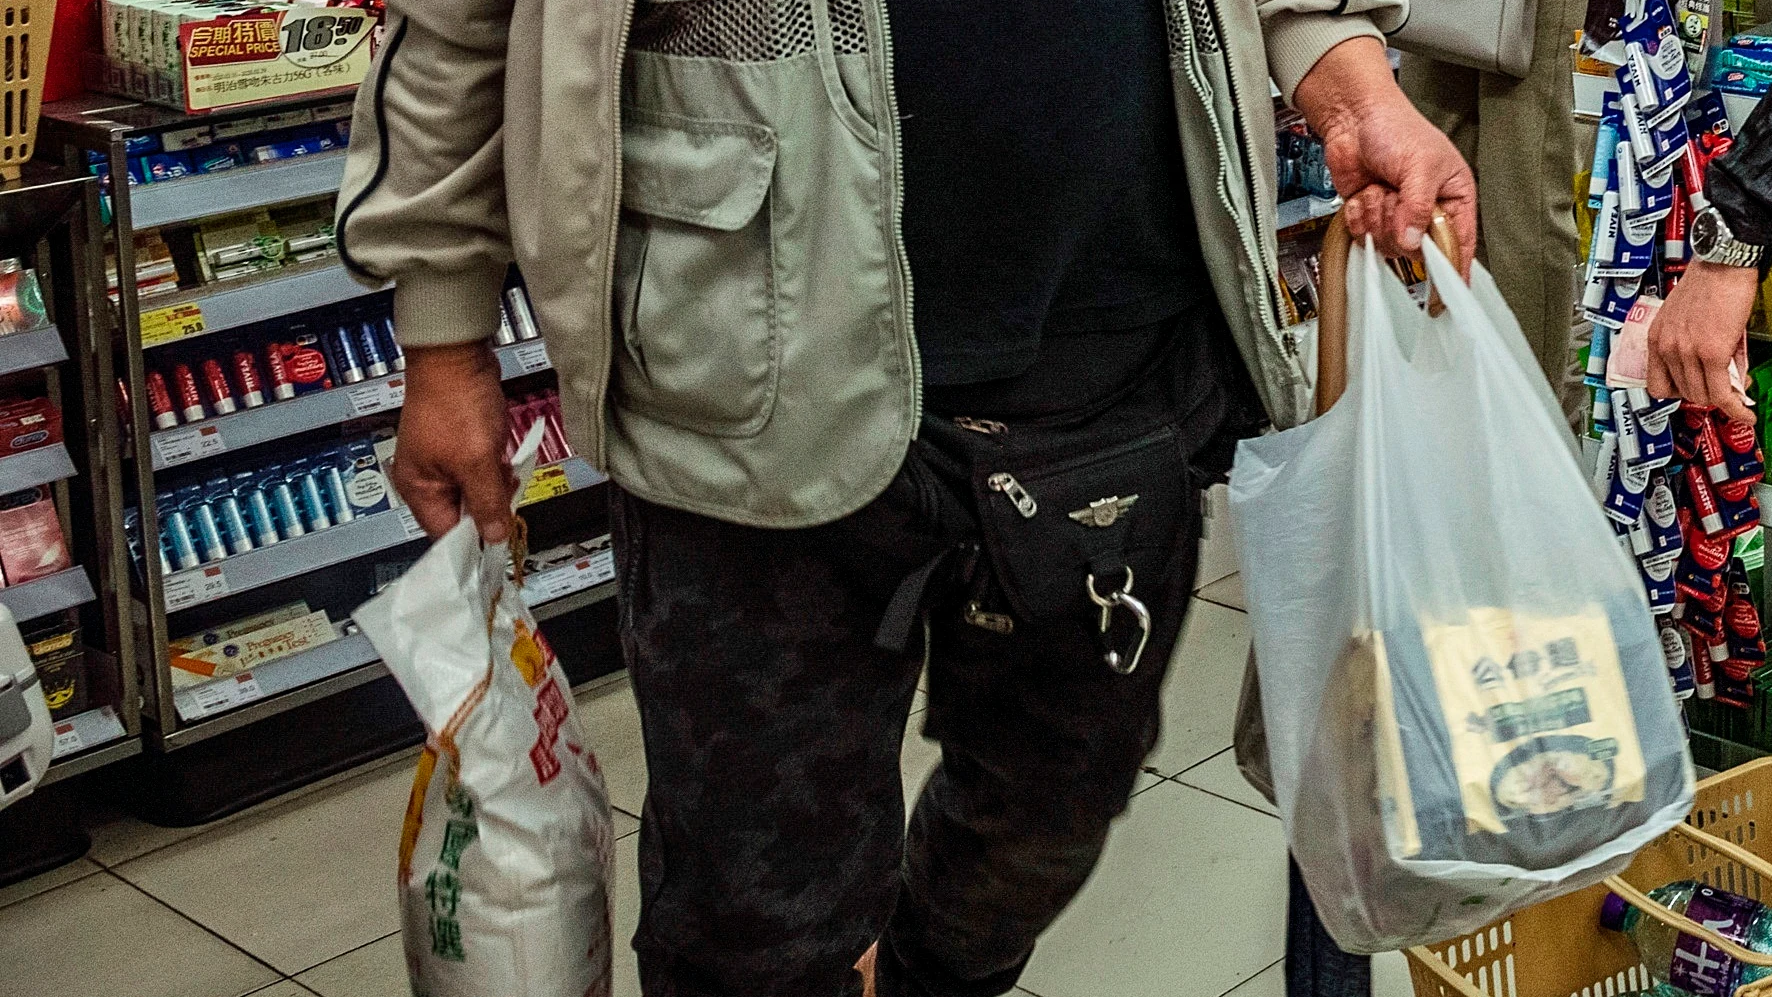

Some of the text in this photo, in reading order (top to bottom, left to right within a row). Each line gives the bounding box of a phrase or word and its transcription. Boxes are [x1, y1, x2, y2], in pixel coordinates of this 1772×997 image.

[193, 20, 278, 45] 今期特價
[189, 42, 281, 58] SPECIAL PRICE
[1628, 54, 1641, 87] NIVEA
[1607, 204, 1619, 239] NIVEA
[1630, 306, 1646, 321] 10
